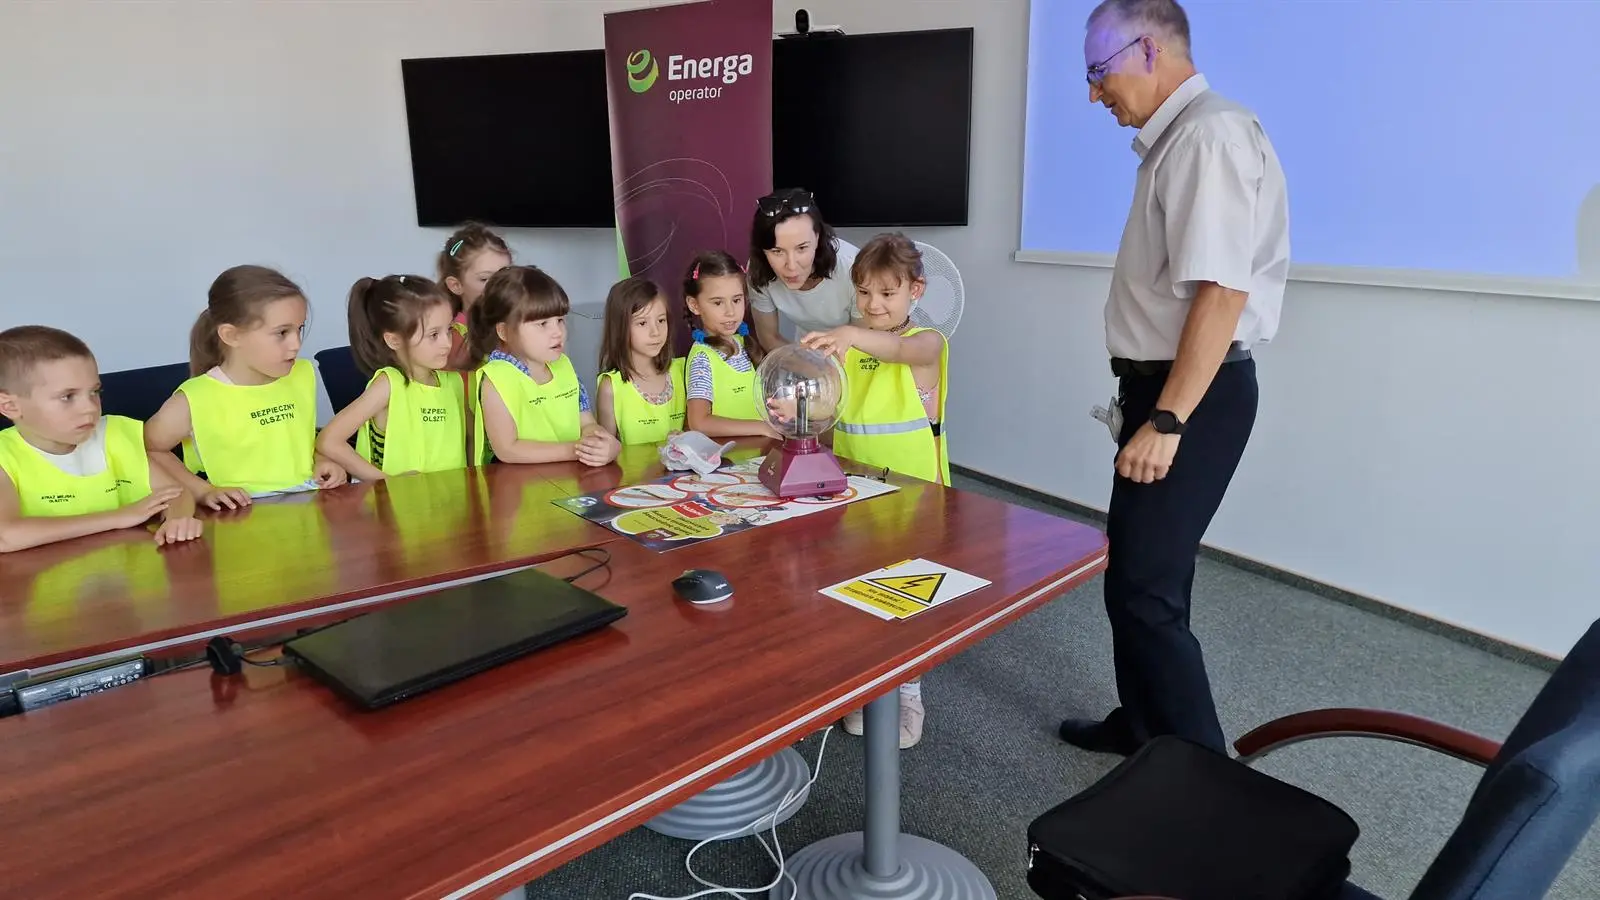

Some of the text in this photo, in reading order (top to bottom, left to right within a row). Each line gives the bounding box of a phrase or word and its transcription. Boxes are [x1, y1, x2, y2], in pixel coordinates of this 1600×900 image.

[668, 53, 753, 84] Energa
[669, 86, 722, 104] operator
[250, 403, 295, 419] BEZPIECZNY
[259, 412, 295, 426] OLSZTYN
